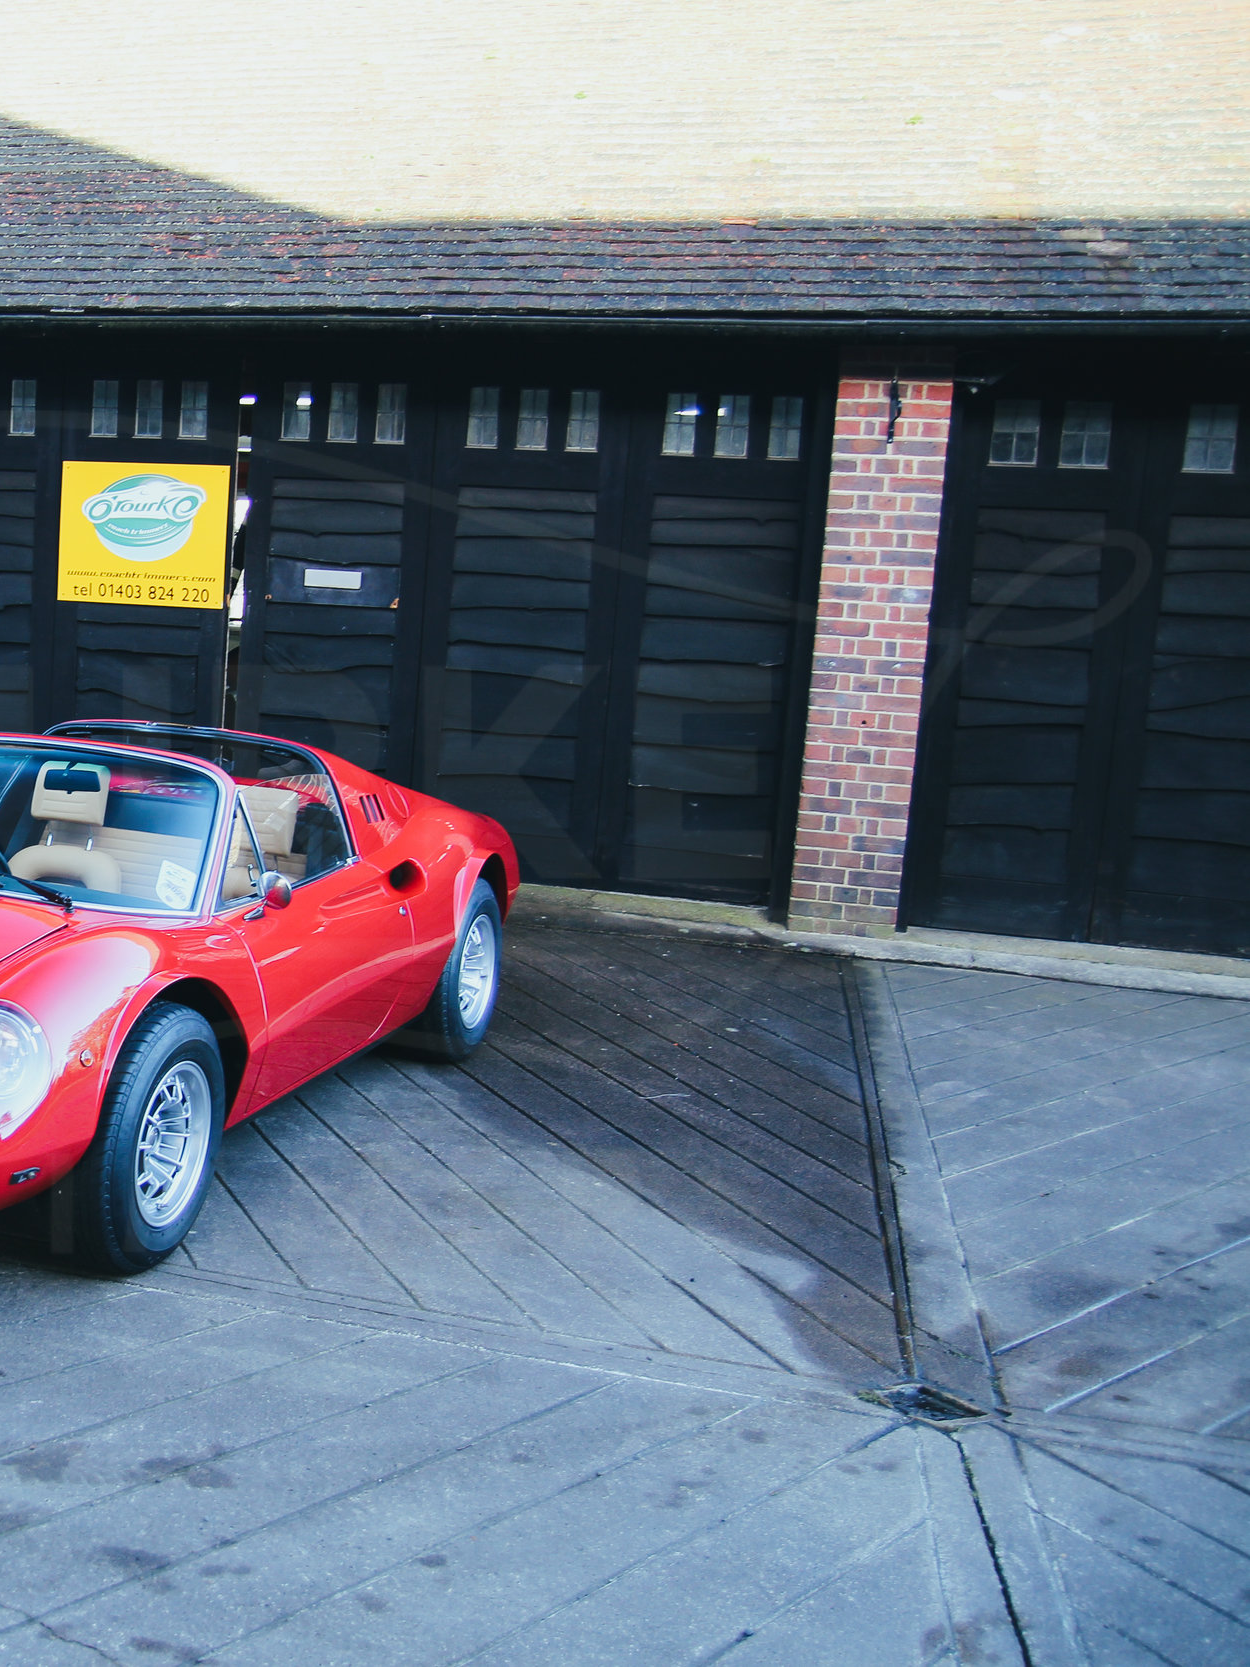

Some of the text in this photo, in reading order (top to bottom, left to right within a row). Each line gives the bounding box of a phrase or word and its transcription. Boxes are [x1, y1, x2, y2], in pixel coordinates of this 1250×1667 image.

[67, 569, 216, 582] www.coachtrimmers.com
[73, 583, 210, 603] tel 01403 824 220
